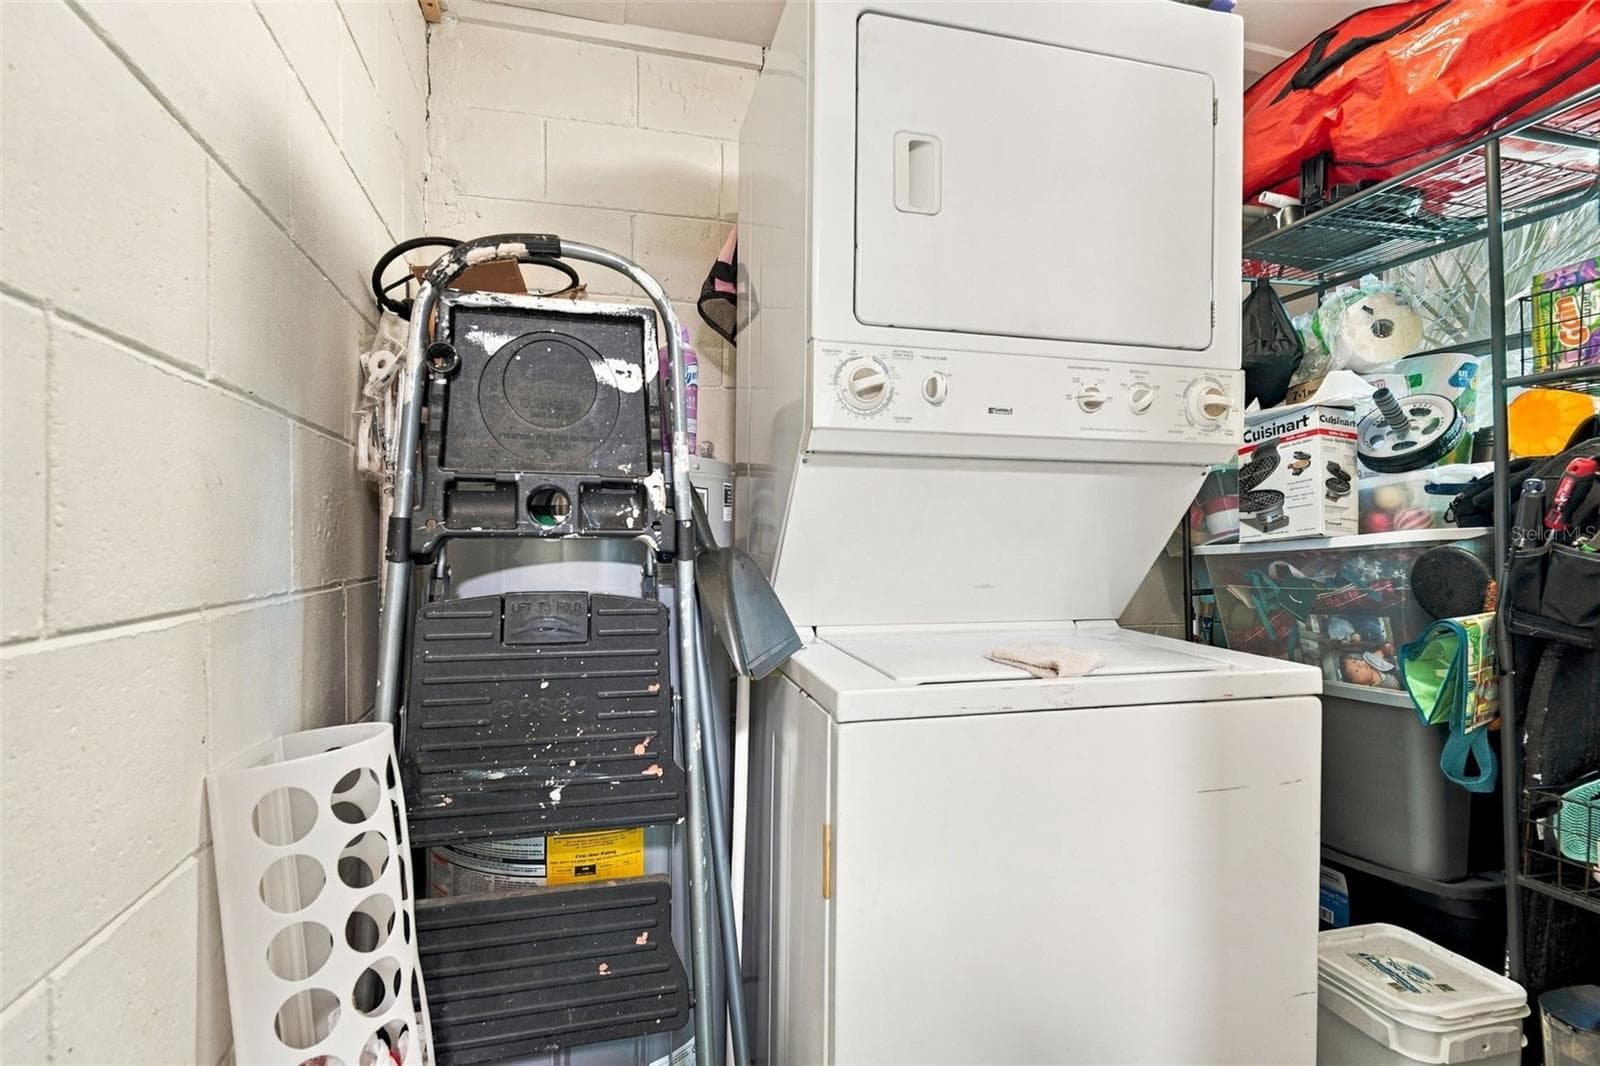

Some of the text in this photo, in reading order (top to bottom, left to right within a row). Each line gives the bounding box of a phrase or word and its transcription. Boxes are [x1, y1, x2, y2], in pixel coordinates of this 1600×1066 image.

[1319, 414, 1356, 427] Cuisinart
[1243, 414, 1310, 443] Cuisinart
[556, 601, 582, 613] FOLD
